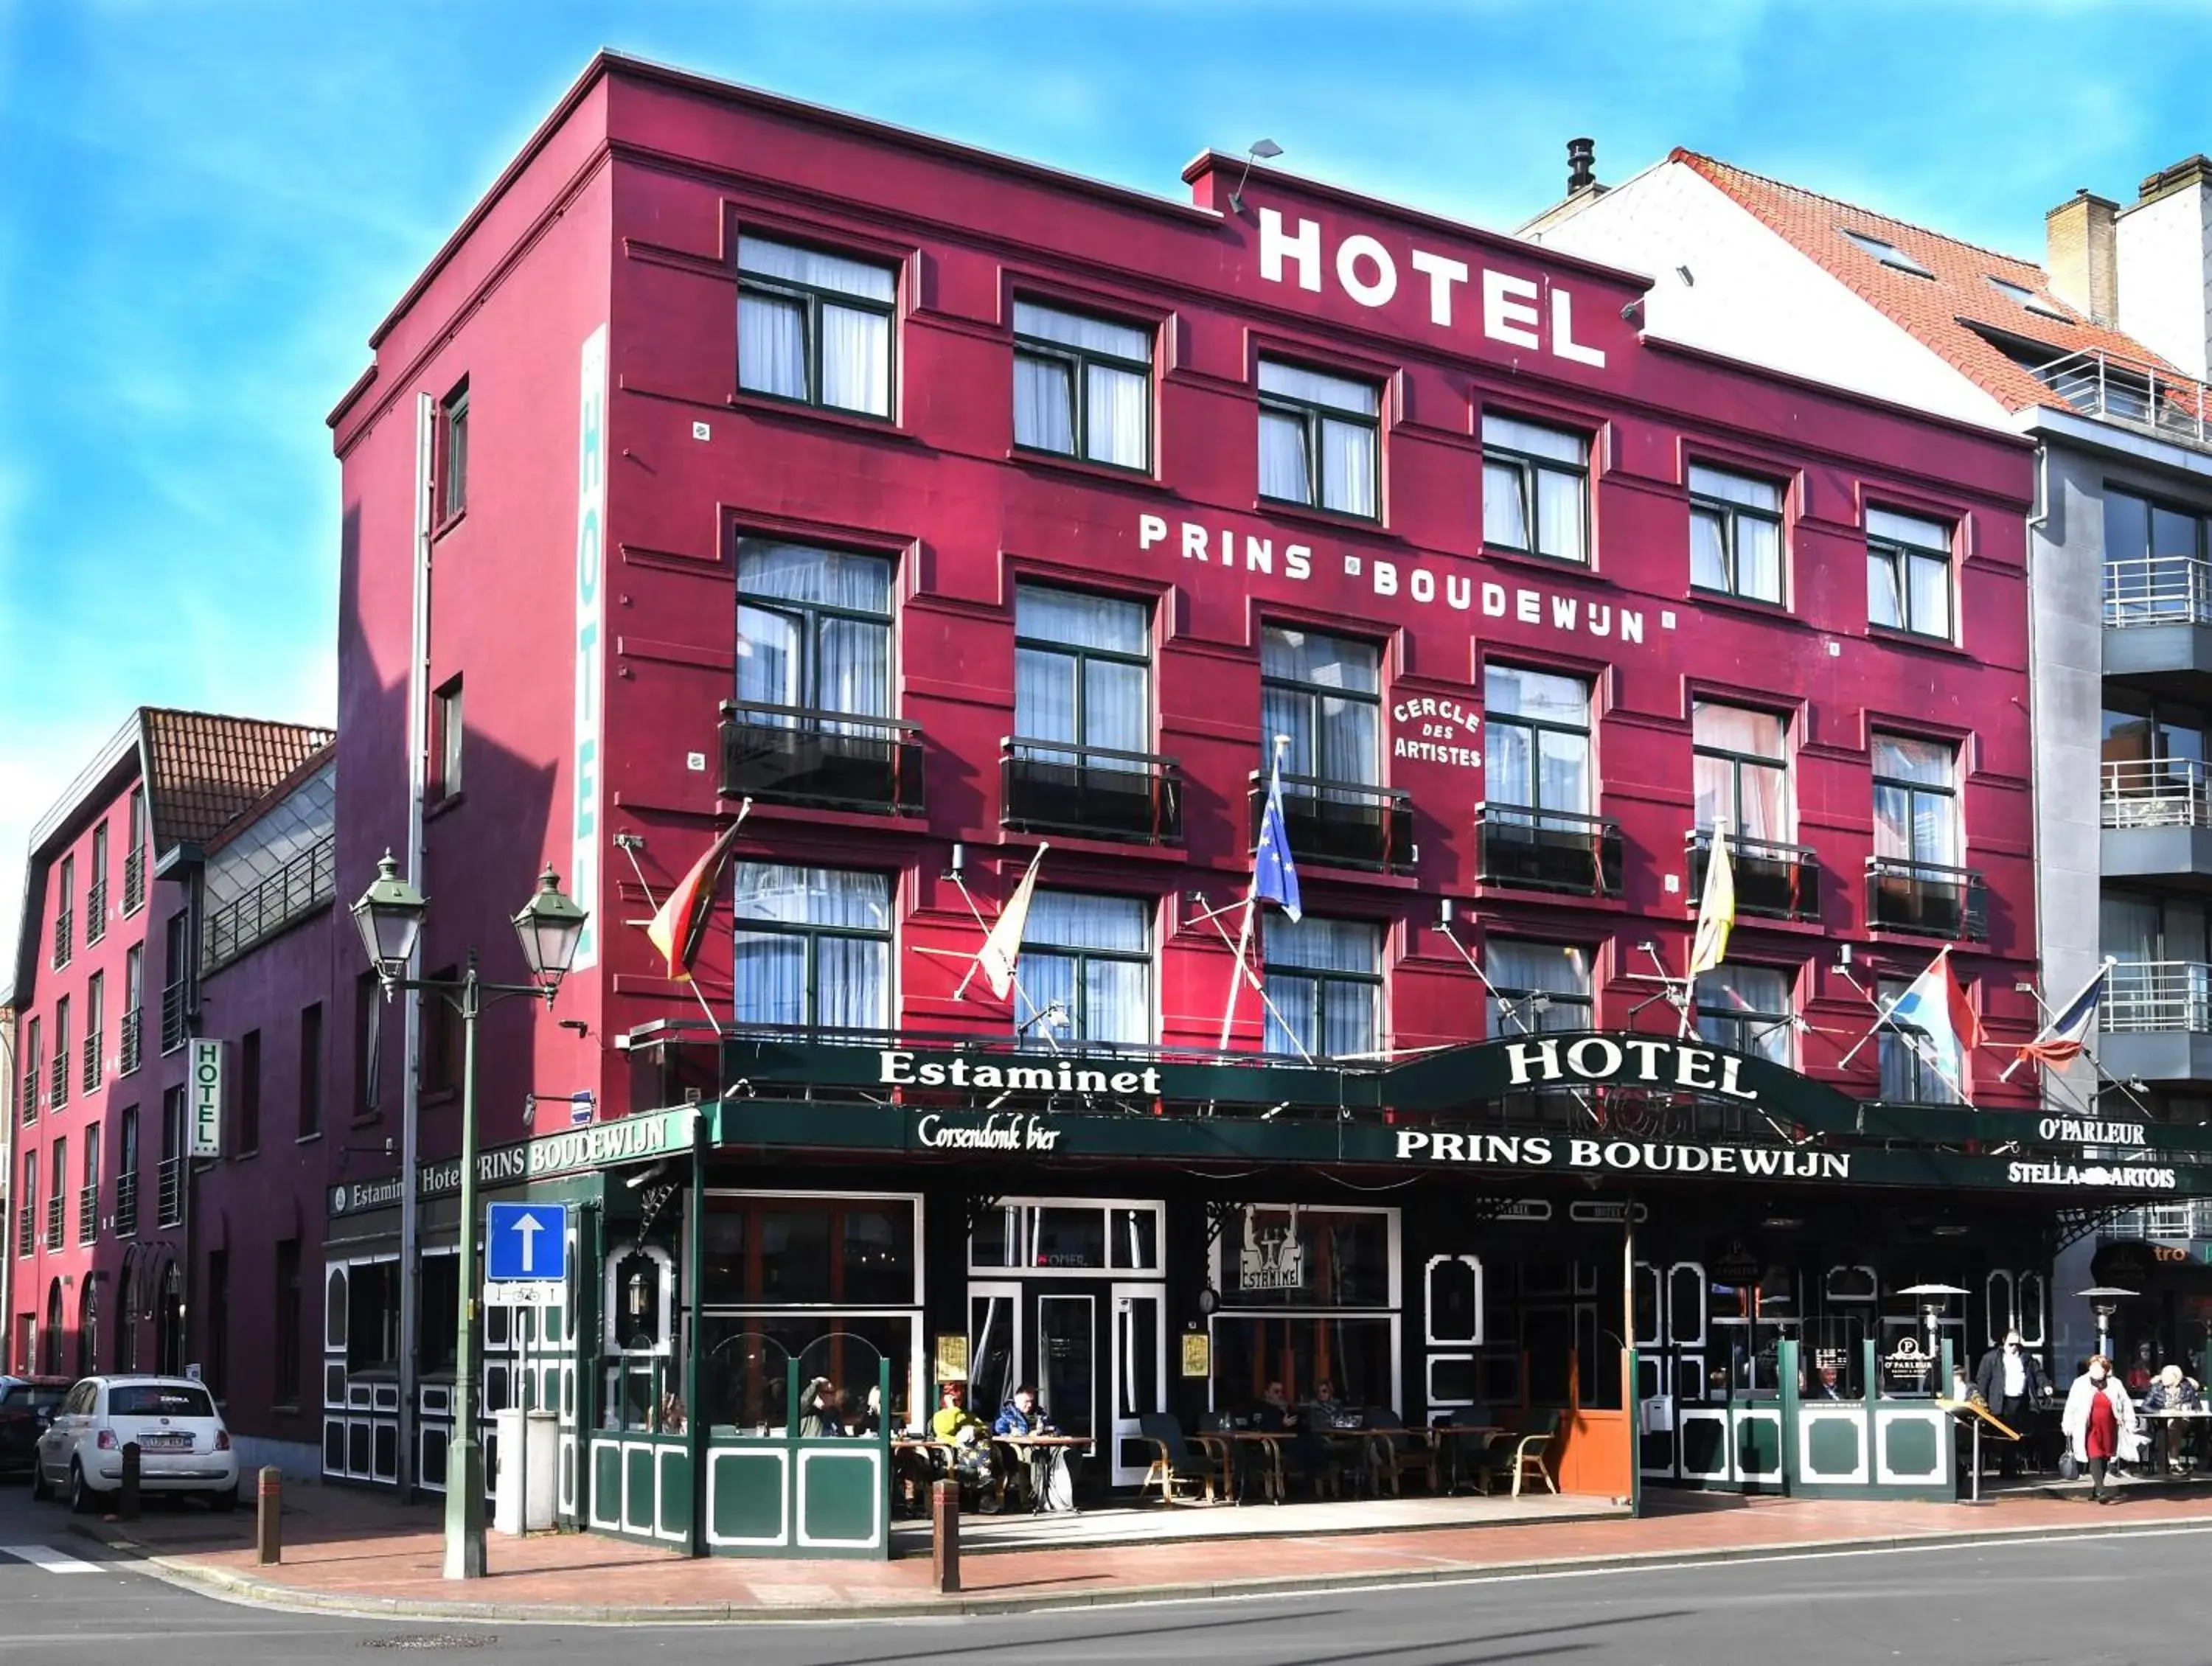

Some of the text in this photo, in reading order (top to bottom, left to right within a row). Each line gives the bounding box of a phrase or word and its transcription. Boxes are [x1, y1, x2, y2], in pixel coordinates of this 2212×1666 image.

[1258, 206, 1606, 369] HOTEL
[1139, 514, 1312, 580] PRINS
[578, 391, 600, 955] HOTEL
[1394, 697, 1480, 733] CERCLE
[1422, 722, 1454, 739] DES
[1394, 736, 1481, 767] ARTISTES
[879, 1050, 1162, 1095] Estaminet
[1504, 1036, 1759, 1101] HOTEL
[198, 1044, 218, 1143] HOTEL
[918, 1113, 1060, 1151] Corsendonk bier
[2039, 1118, 2146, 1145] O'PARLEUR
[352, 1177, 406, 1207] Estamin
[477, 1148, 524, 1181] RINS
[530, 1118, 668, 1172] BOUDEWIJN
[1395, 1130, 1851, 1179] PRINS BOUDEWIJN
[2008, 1160, 2176, 1189] STELLA ARTOIS
[1242, 1257, 1301, 1288] ESTAMINET
